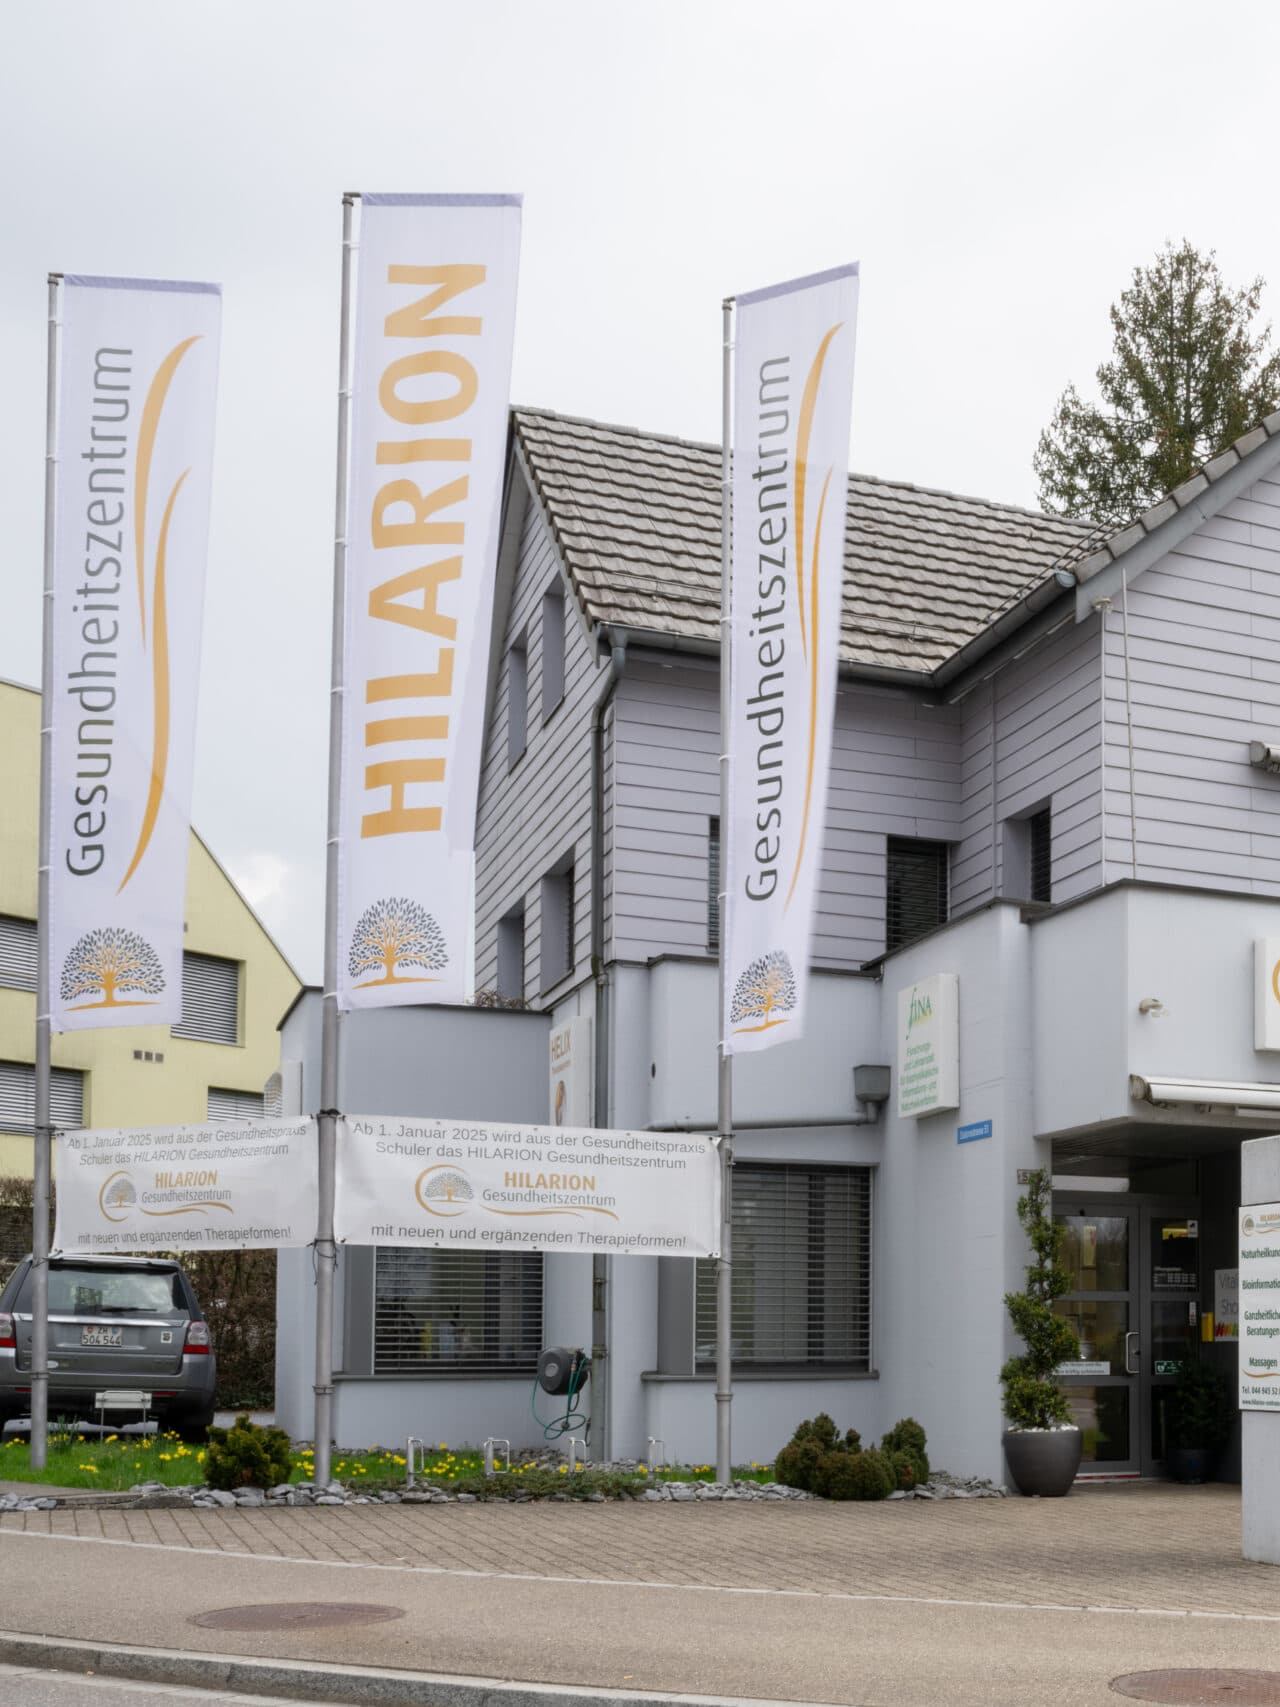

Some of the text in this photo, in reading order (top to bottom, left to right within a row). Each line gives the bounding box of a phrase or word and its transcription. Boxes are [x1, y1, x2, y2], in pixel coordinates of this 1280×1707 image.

[360, 263, 487, 839] HILARION
[65, 345, 133, 877] Gesundheitszentrum
[745, 354, 791, 903] Gesundheitszentrum
[68, 1137, 81, 1150] Ab
[93, 1136, 125, 1149] Januar
[127, 1134, 151, 1147] 2025
[154, 1132, 174, 1145] wird
[176, 1133, 194, 1145] aus
[196, 1130, 213, 1143] der
[353, 1122, 706, 1156] Ab 1. Januar 2025 wird aus der Gesundheitspraxis
[80, 1143, 289, 1166] Schuler das HILARION Gesundheitszentrum
[375, 1141, 687, 1169] Schuler das HILARION Gesundheitszentrum
[155, 1170, 218, 1189] HILARION
[504, 1170, 596, 1192] HILARION
[141, 1188, 232, 1204] Gesundheitszentrum
[482, 1188, 616, 1207] Gesundheitszentrum
[78, 1231, 91, 1245] mit
[95, 1233, 119, 1245] neuen
[121, 1231, 138, 1243] und
[204, 1226, 291, 1243] Therapieformen!
[371, 1224, 687, 1248] mit neuen und ergänzenden Therapieformen!
[82, 1335, 121, 1345] 504 544
[1247, 1326, 1280, 1338] Beratungen
[1249, 1357, 1278, 1369] Massagen
